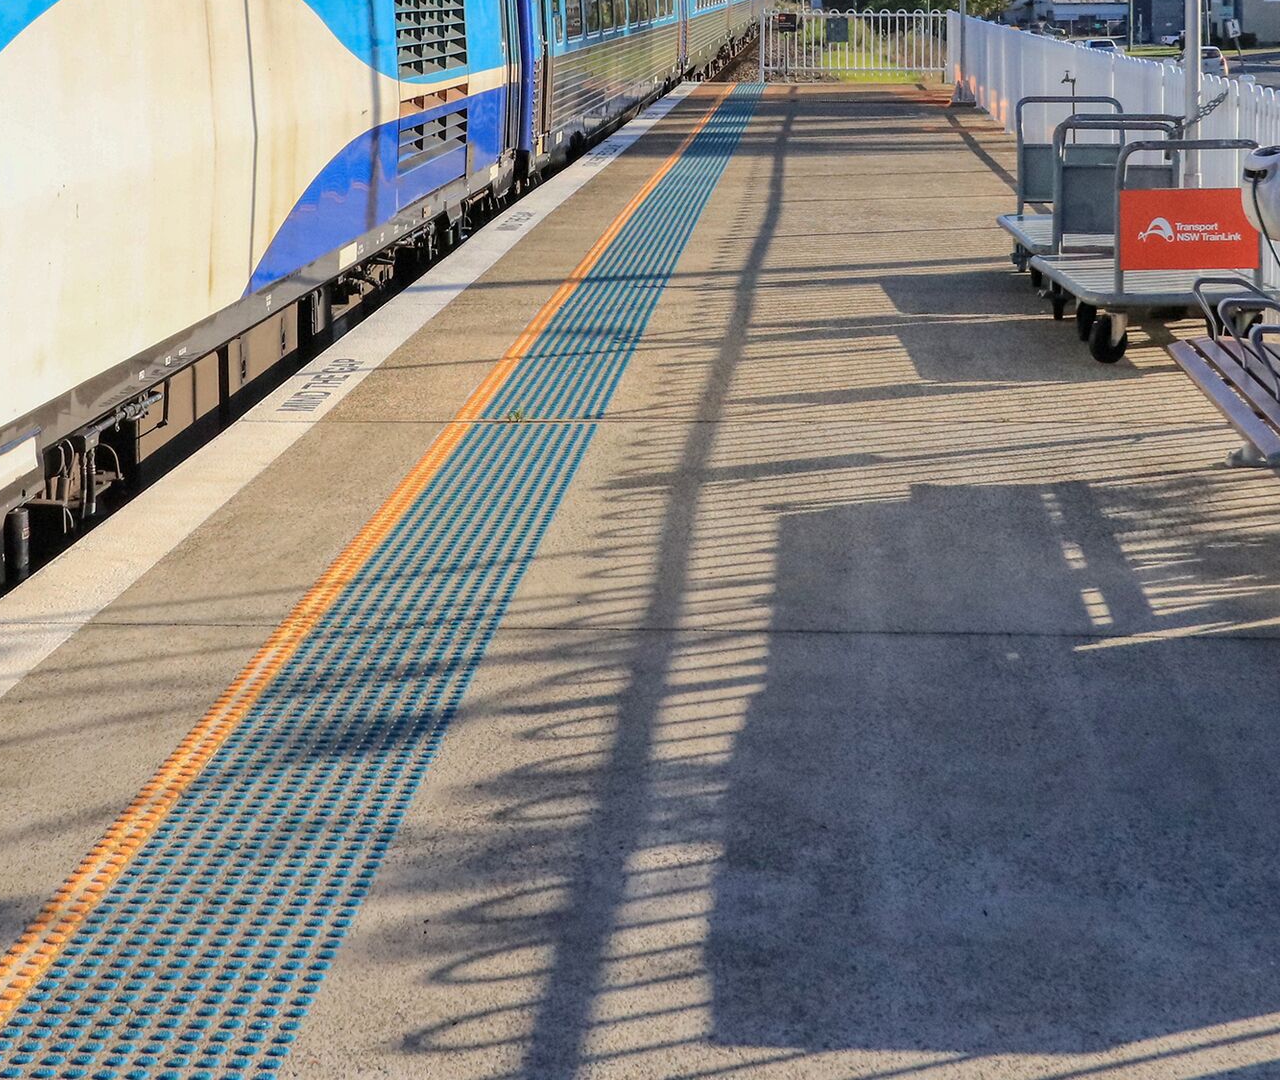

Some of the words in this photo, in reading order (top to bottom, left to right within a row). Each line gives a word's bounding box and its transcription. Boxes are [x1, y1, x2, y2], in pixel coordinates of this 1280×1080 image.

[1175, 222, 1218, 232] Transport
[1176, 233, 1200, 242] NSW
[1201, 232, 1242, 242] TrainLink
[300, 374, 351, 390] THE
